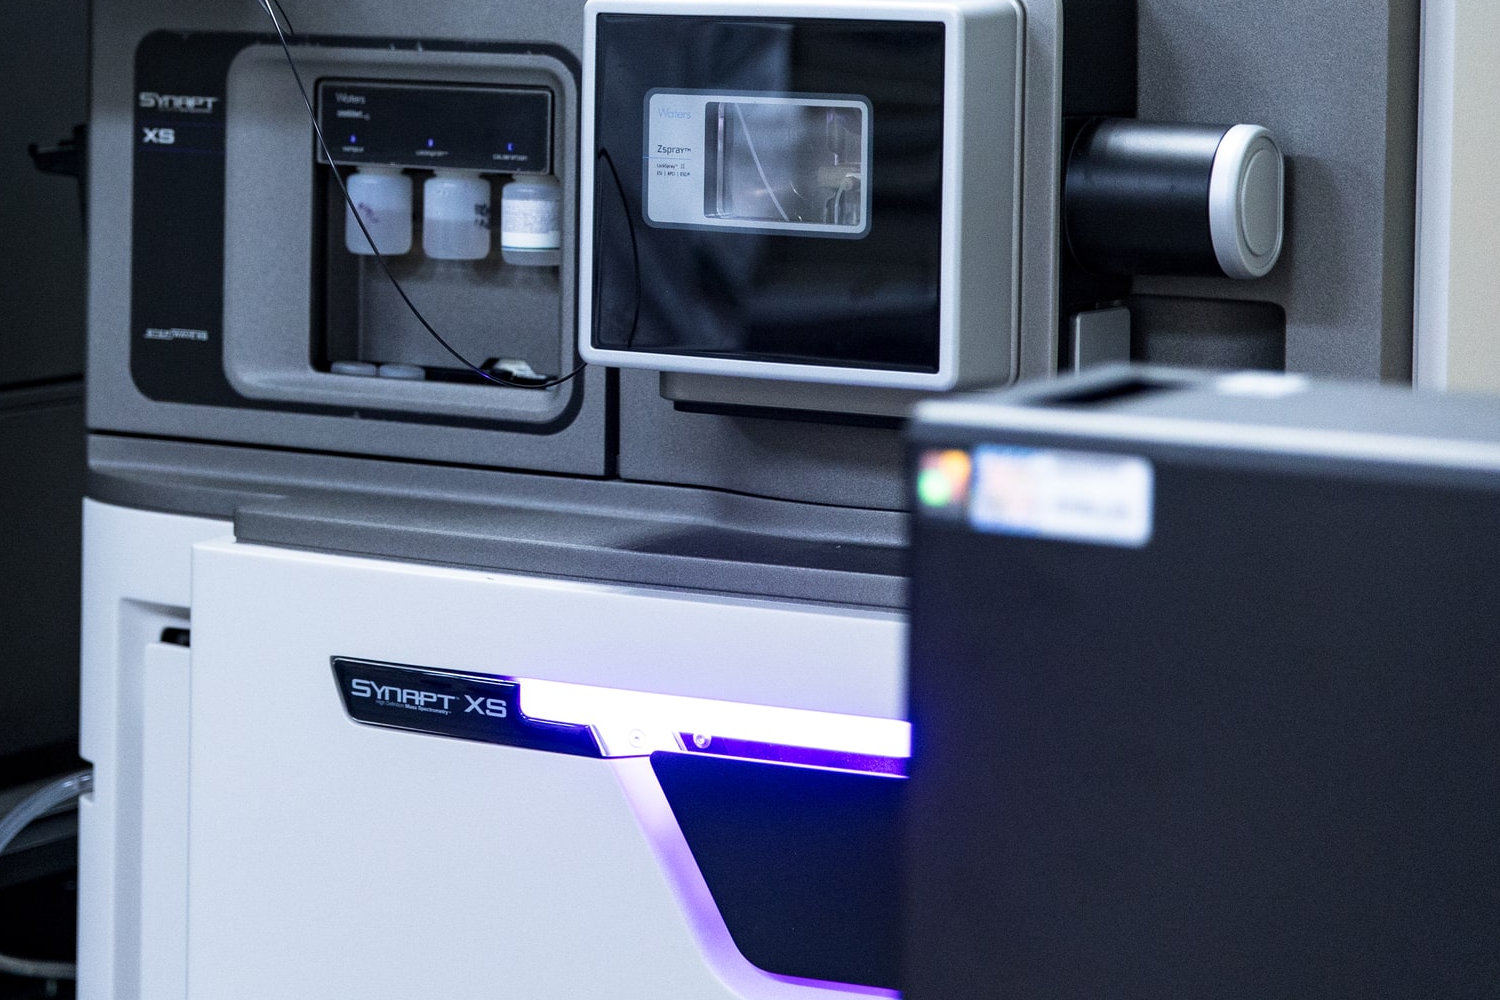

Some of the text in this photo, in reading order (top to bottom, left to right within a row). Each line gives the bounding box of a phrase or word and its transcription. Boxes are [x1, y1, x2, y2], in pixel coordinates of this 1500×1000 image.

[658, 106, 692, 119] Waters
[142, 126, 175, 145] XS
[463, 694, 507, 718] XS
